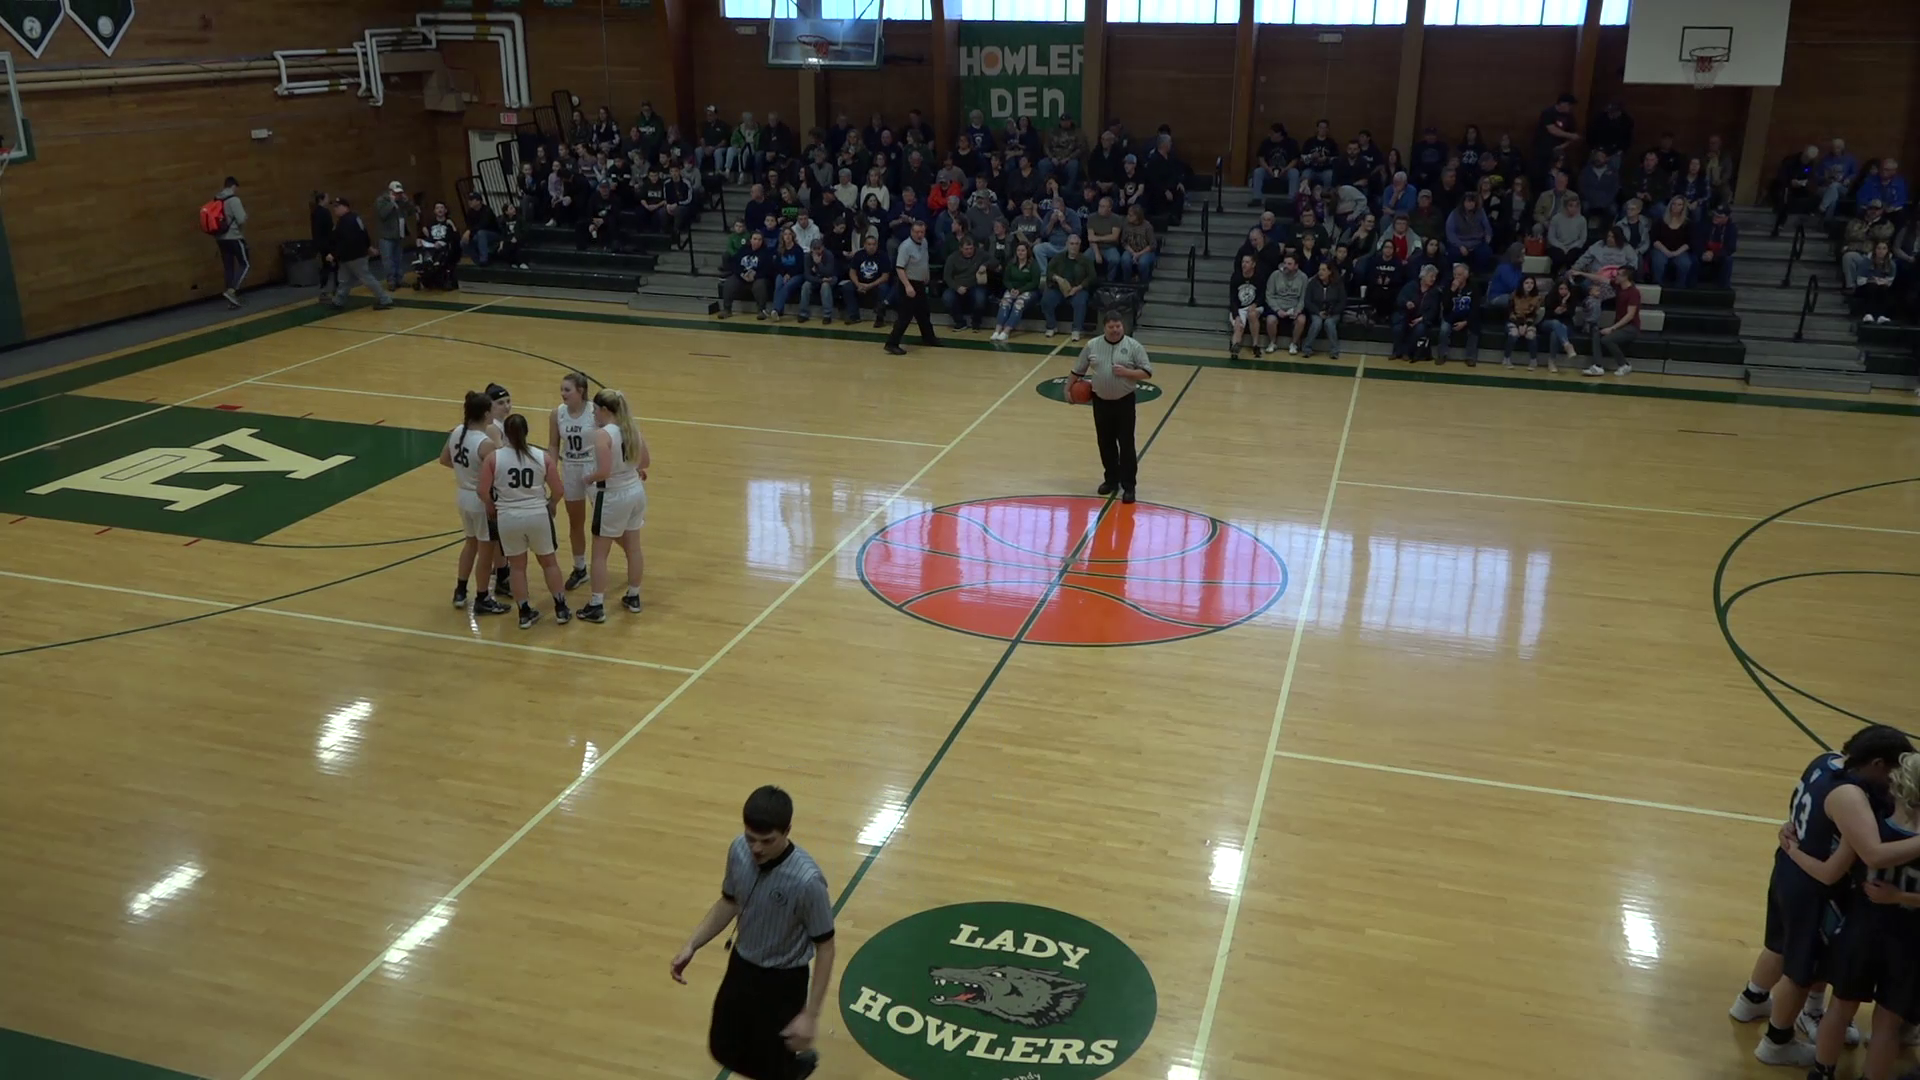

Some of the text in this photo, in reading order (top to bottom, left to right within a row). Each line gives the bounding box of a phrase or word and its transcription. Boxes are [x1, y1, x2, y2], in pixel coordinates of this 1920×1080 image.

[567, 434, 582, 451] 10
[507, 467, 534, 489] 30
[949, 923, 1090, 970] LADY
[848, 986, 1119, 1066] HOWLERS
